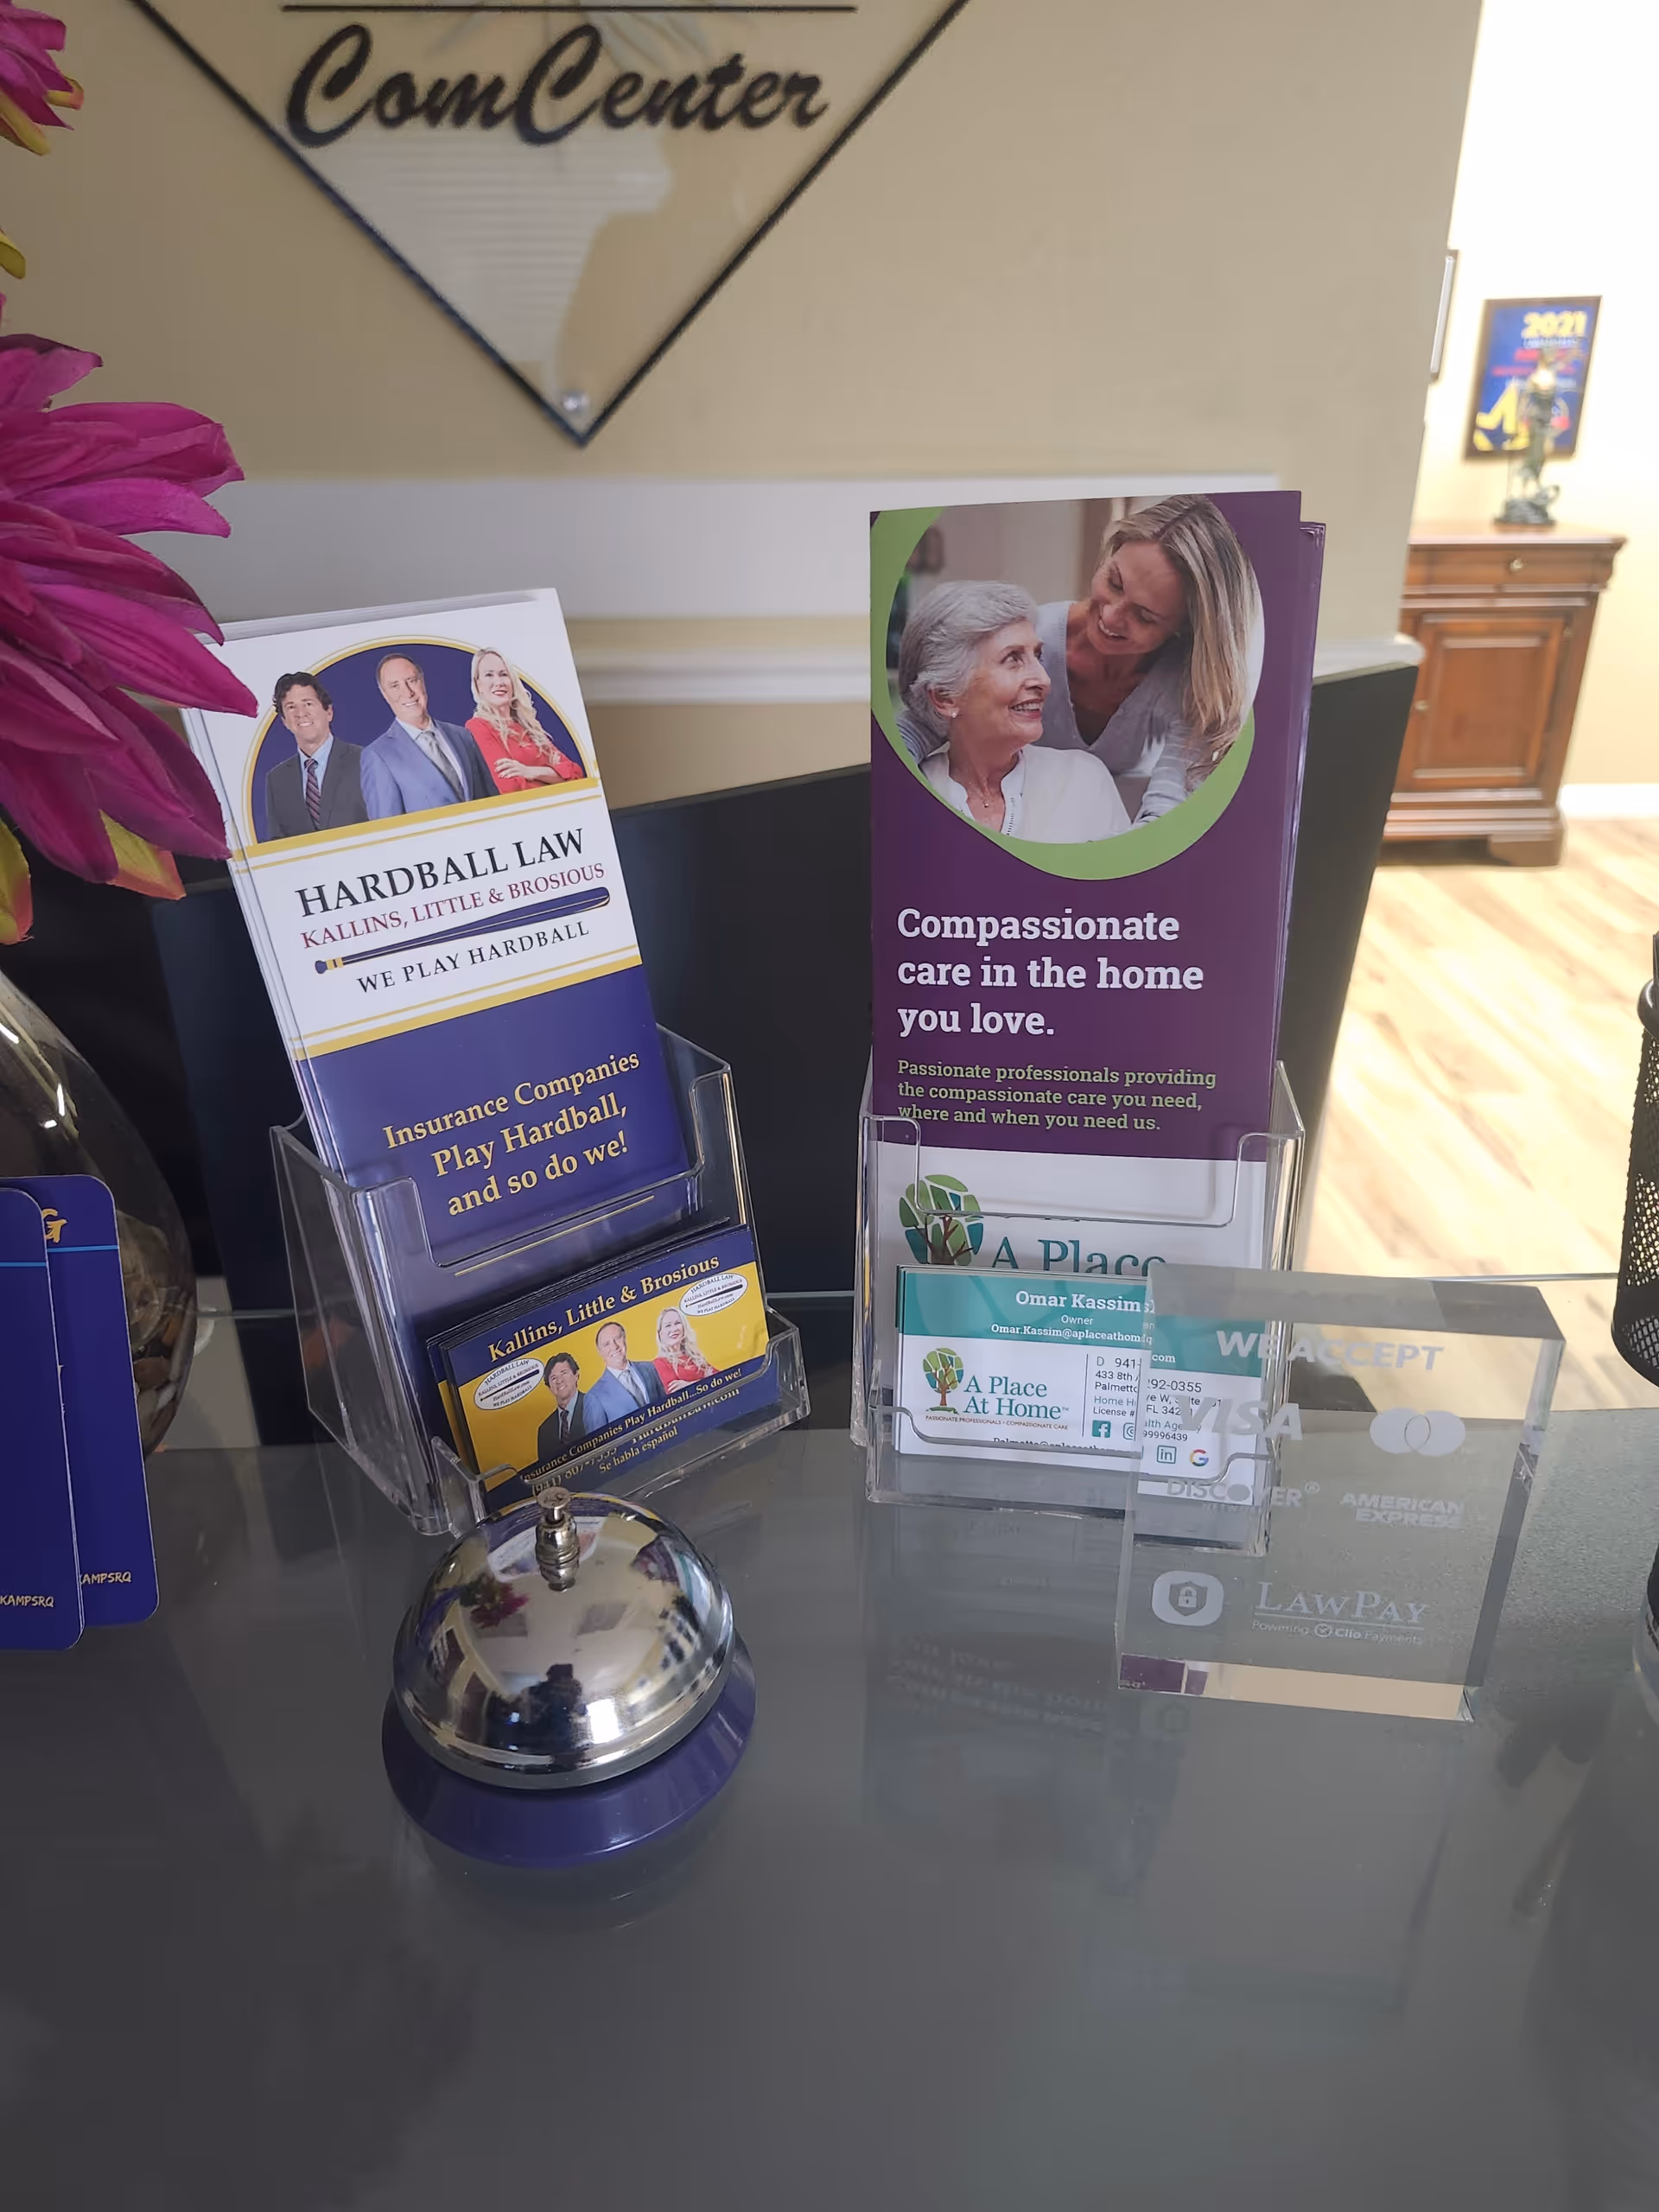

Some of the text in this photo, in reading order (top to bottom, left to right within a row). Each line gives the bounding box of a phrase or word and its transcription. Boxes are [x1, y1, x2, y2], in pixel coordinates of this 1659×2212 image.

[285, 24, 828, 147] ComCenter
[296, 829, 584, 917] HARDBALL LAW
[302, 862, 605, 949] KALLINS, LITTLE & BROSIOUS
[898, 907, 1179, 947] Compassionate
[357, 921, 589, 994] WE PLAY HARDBALL
[898, 955, 1205, 990] care in the home
[897, 1001, 1055, 1038] you love.
[897, 1059, 1217, 1090] Passionate professionals providing
[382, 1052, 640, 1149] Insurance Companies
[897, 1082, 1203, 1112] the compassionate care you need,
[431, 1091, 627, 1177] Play Hardball,
[897, 1105, 1161, 1131] where and when you need us.
[448, 1129, 628, 1216] and so do we!
[992, 1236, 1019, 1269] A
[691, 1277, 721, 1294] HARDBALL
[1015, 1290, 1067, 1308] Omar
[1071, 1294, 1141, 1313] Kassim
[488, 1255, 721, 1363] Kallins, Little & Brosious
[1061, 1314, 1093, 1325] Owner
[1216, 1330, 1445, 1370] WE ACCEPT
[484, 1363, 515, 1385] HARDBALL
[963, 1375, 1047, 1398] A Place
[1096, 1370, 1133, 1381] 433 8th
[569, 1425, 623, 1457] Companies
[624, 1413, 645, 1428] Play
[711, 1376, 723, 1388] do
[724, 1368, 742, 1383] we!
[963, 1395, 989, 1414] At
[1093, 1407, 1127, 1416] License
[1094, 1395, 1123, 1407] Home
[1146, 1404, 1158, 1414] FL
[1175, 1393, 1303, 1442] VISA
[599, 1427, 678, 1473] Se habla español
[1339, 1492, 1465, 1514] AMERICAN
[1355, 1509, 1463, 1529] EXPRESS
[1252, 1619, 1309, 1635] Powering
[1335, 1628, 1362, 1639] Clio
